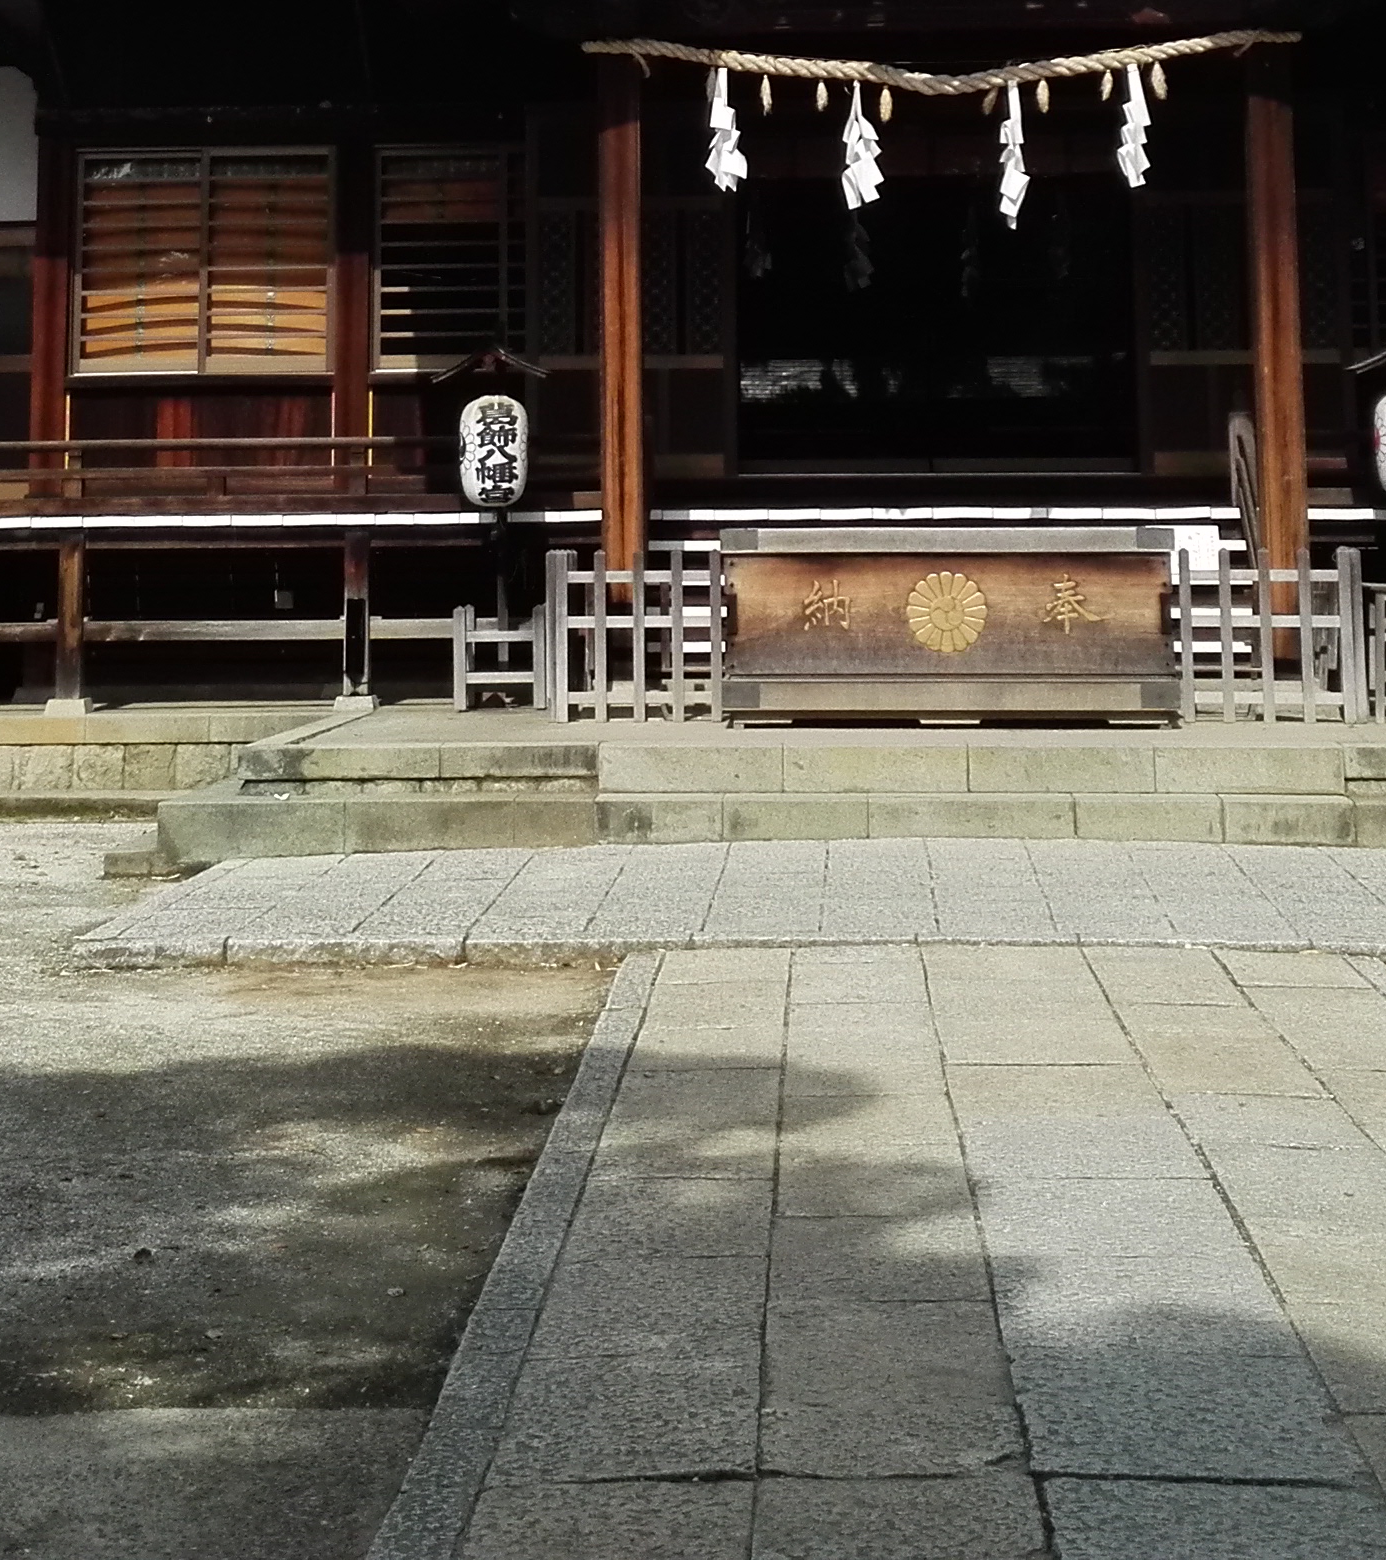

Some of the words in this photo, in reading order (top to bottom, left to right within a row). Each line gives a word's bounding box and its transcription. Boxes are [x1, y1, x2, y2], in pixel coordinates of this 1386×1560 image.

[476, 402, 519, 503] 葛飾八幡宮
[803, 579, 850, 631] 納
[1043, 573, 1106, 635] 奉
